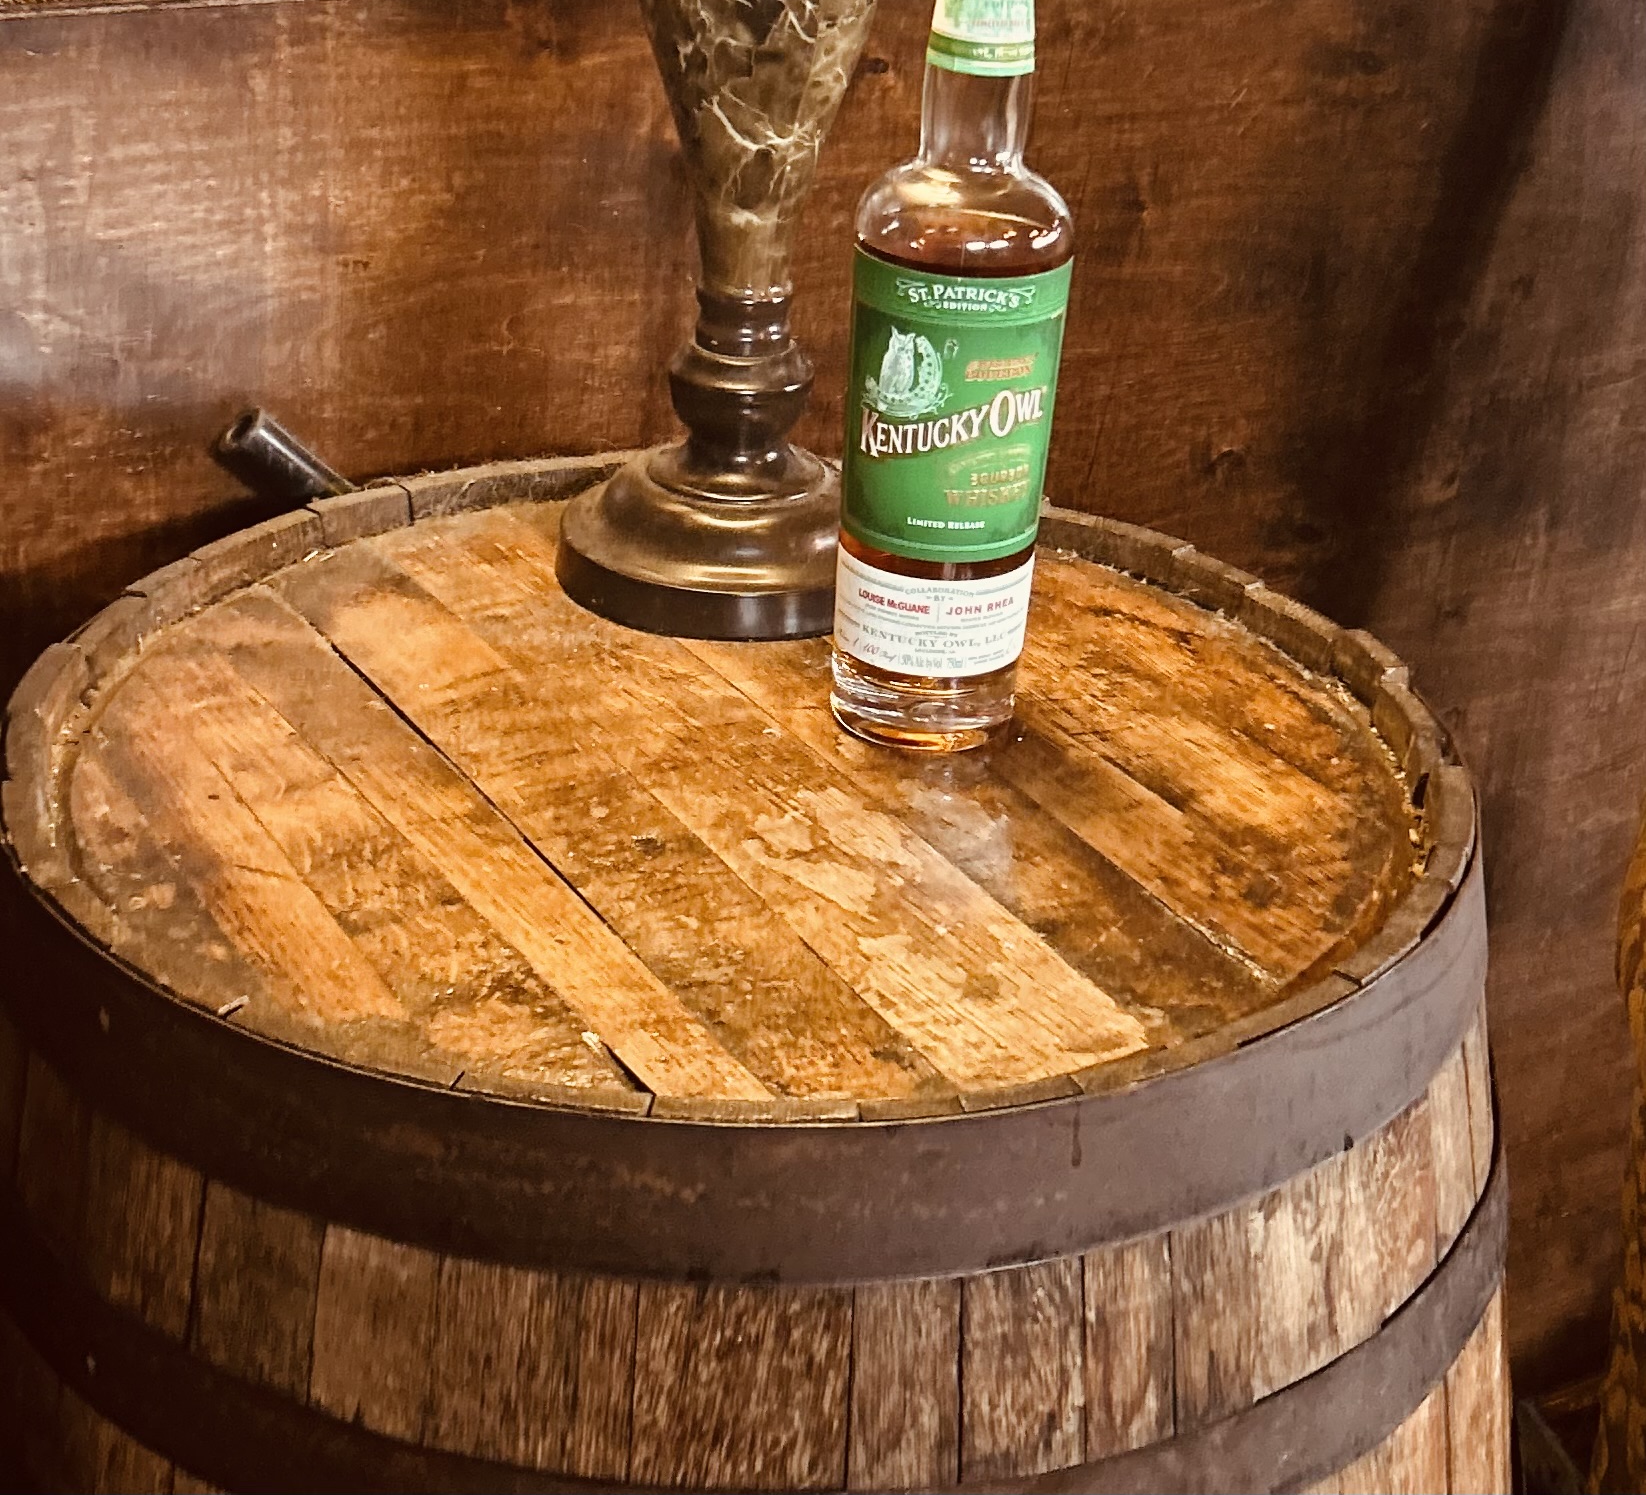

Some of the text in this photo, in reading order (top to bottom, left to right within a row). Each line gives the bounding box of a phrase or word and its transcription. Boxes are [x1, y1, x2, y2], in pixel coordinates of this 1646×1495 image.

[907, 284, 1020, 309] ST. PATRICK'S
[942, 301, 988, 312] EDITION
[860, 406, 991, 458] KENTUCKY
[989, 388, 1044, 438] OWL
[907, 516, 946, 529] LIMITED
[858, 588, 885, 605] LOUISE
[946, 597, 1014, 616] JOHN RHEA
[862, 624, 938, 648] KENTUCKY
